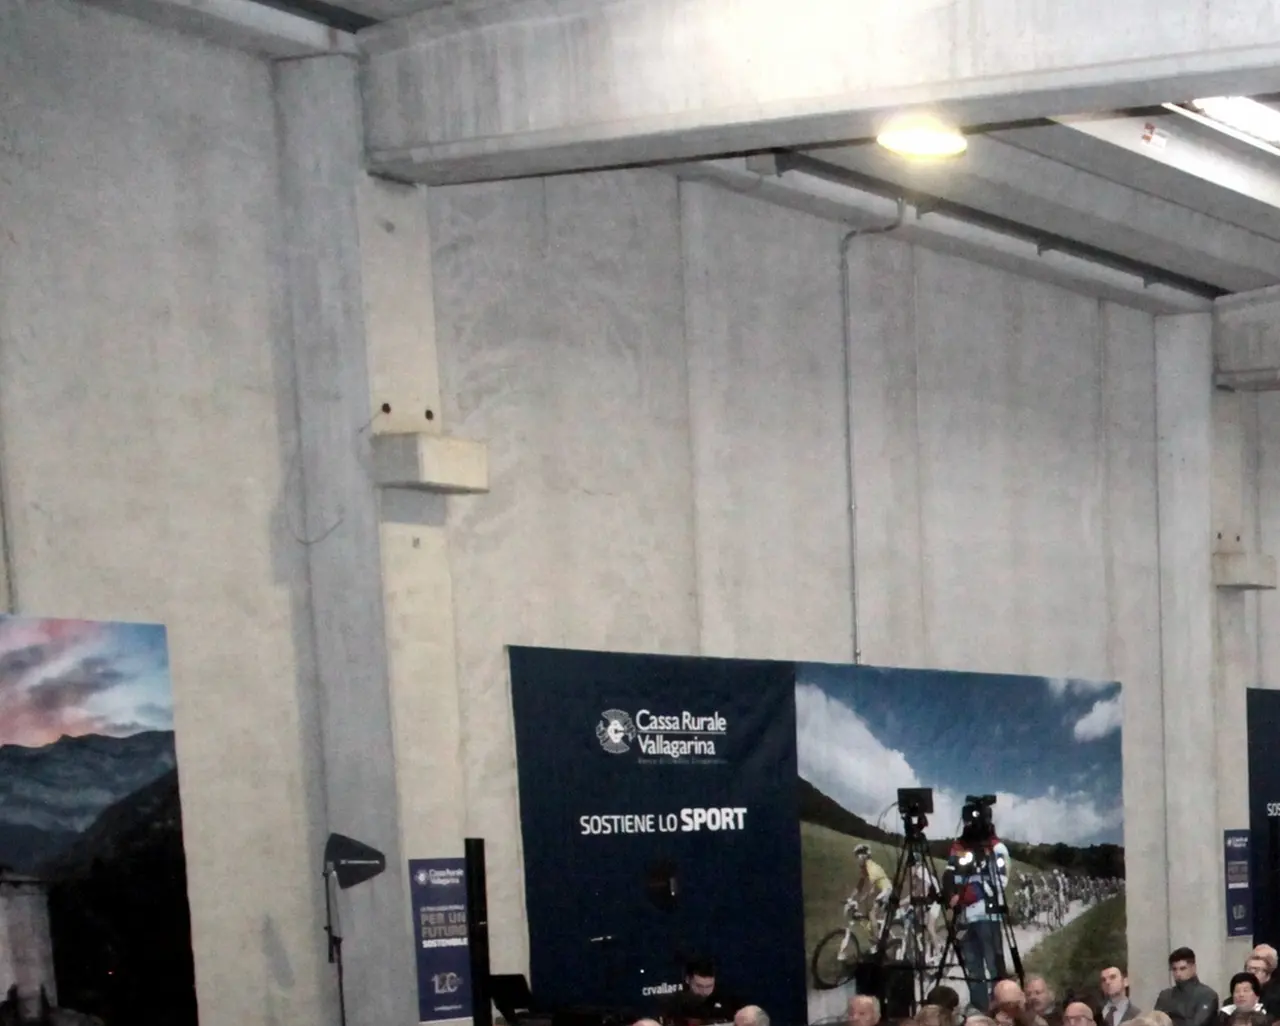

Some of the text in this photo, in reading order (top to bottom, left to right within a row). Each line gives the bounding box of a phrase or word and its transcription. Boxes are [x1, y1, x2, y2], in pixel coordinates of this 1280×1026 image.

[635, 709, 727, 732] Cassa Rurale
[637, 734, 716, 758] Vallagarina
[579, 807, 748, 835] SOSTIENE LO SPORT
